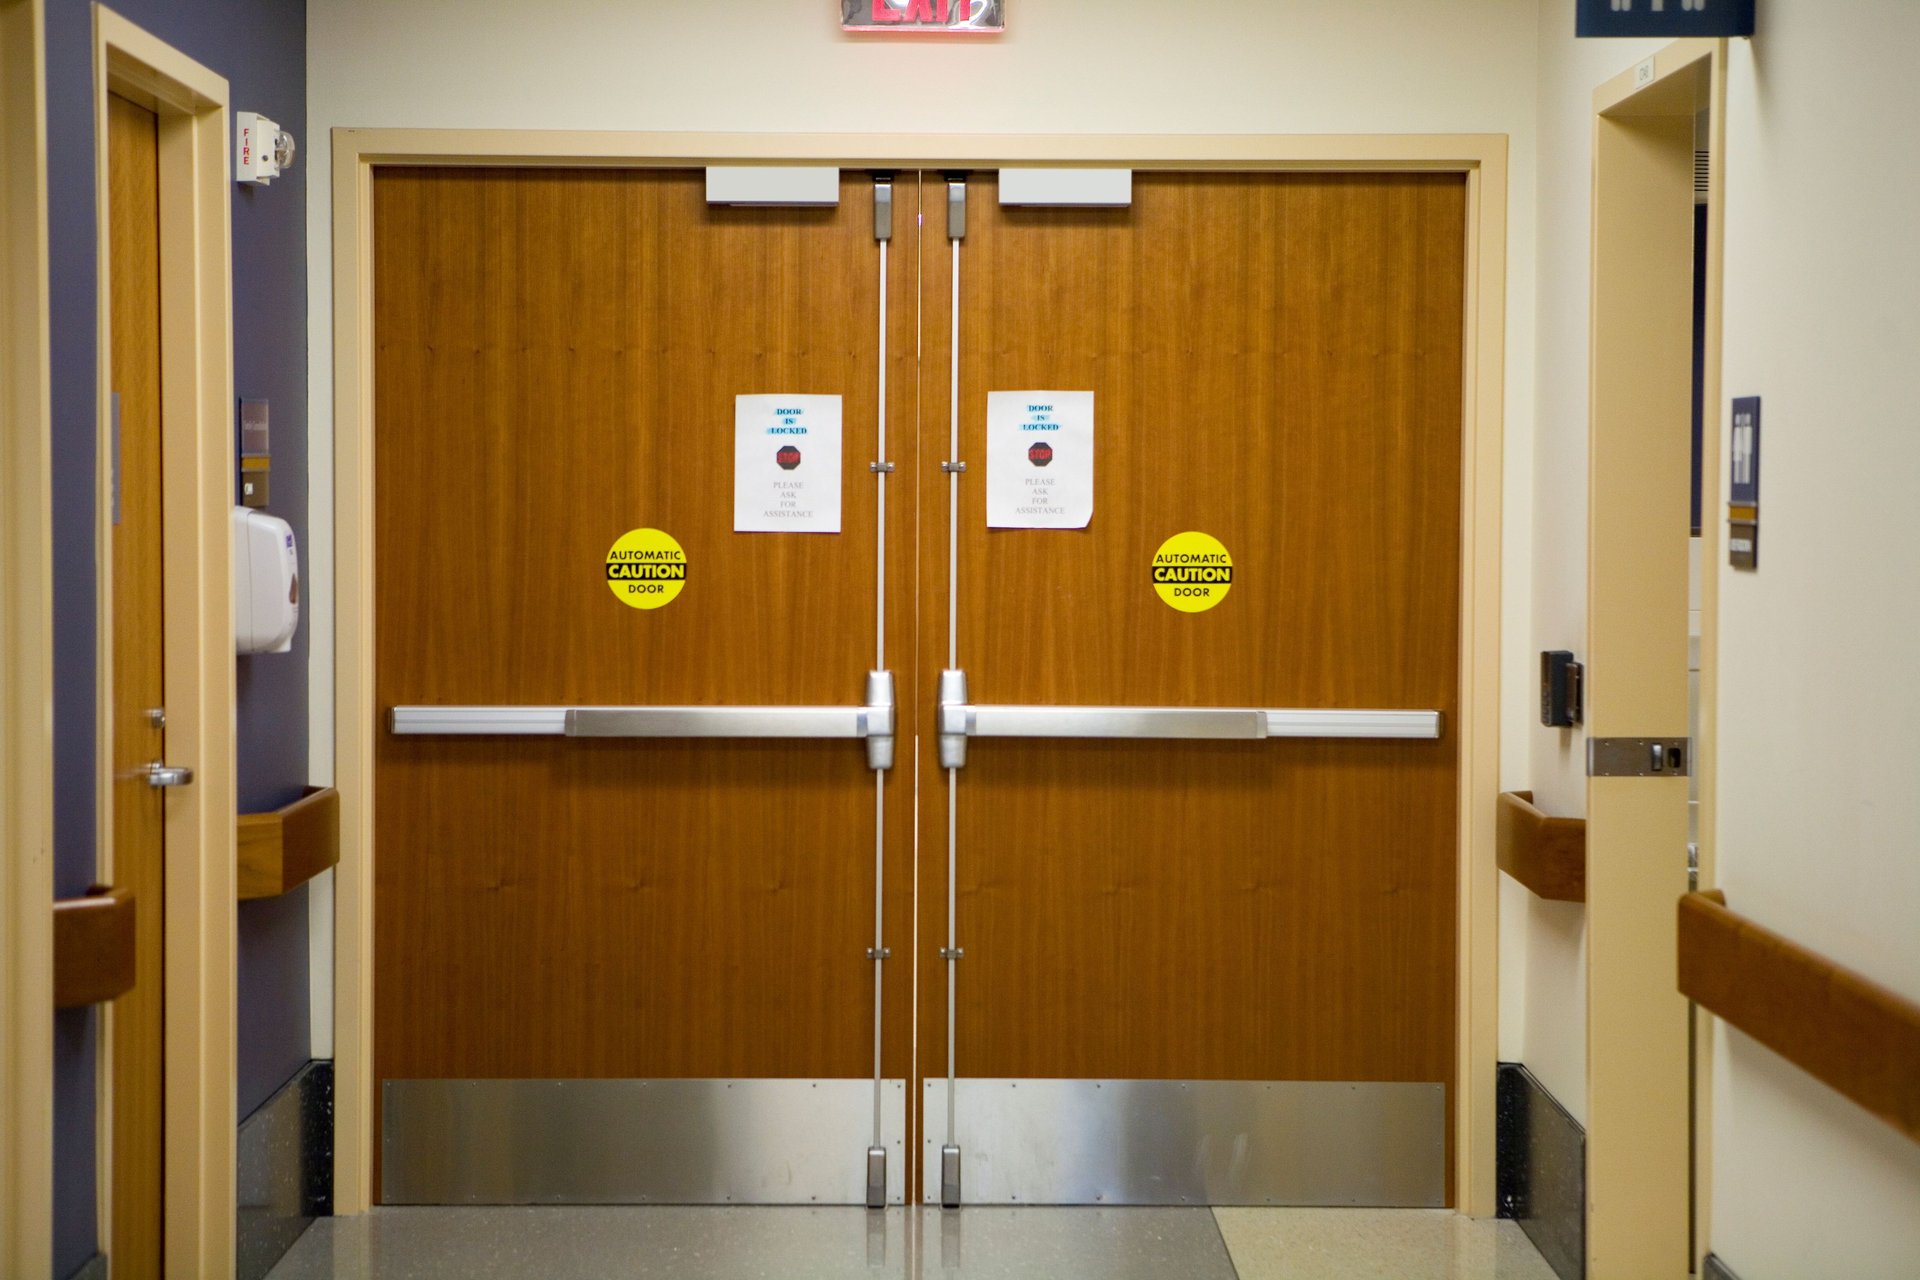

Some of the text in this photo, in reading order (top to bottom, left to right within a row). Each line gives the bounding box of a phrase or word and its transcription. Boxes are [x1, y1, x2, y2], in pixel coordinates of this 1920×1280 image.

[777, 452, 800, 463] STOP
[1028, 449, 1051, 459] STOP
[1025, 478, 1056, 486] PLEASE
[780, 491, 797, 499] ASK
[1032, 497, 1048, 505] FOR
[763, 510, 814, 518] ASSISTANCE
[610, 551, 681, 560] AUTOMATIC
[1156, 554, 1227, 563] AUTOMATIC
[608, 564, 684, 578] CAUTION
[1154, 568, 1230, 582] CAUTION
[628, 584, 664, 593] DOOR
[1174, 588, 1210, 597] DOOR
